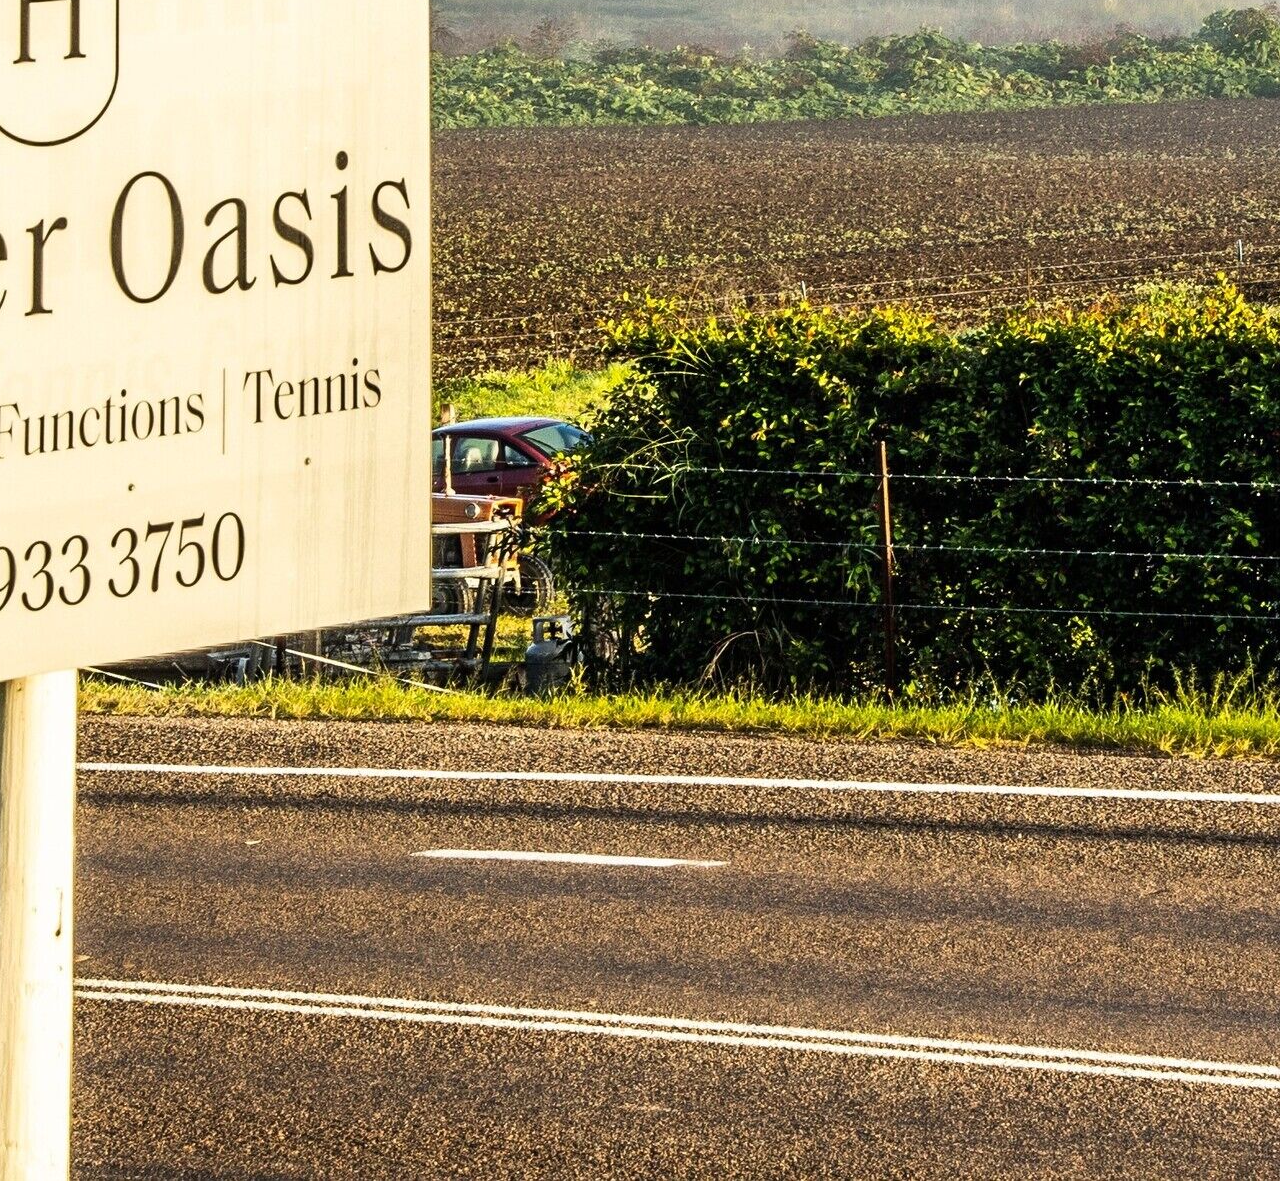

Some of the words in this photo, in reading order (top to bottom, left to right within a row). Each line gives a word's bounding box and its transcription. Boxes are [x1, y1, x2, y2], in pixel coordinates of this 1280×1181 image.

[109, 149, 413, 305] Oasis
[243, 356, 383, 426] Tennis
[107, 510, 247, 599] 3750
